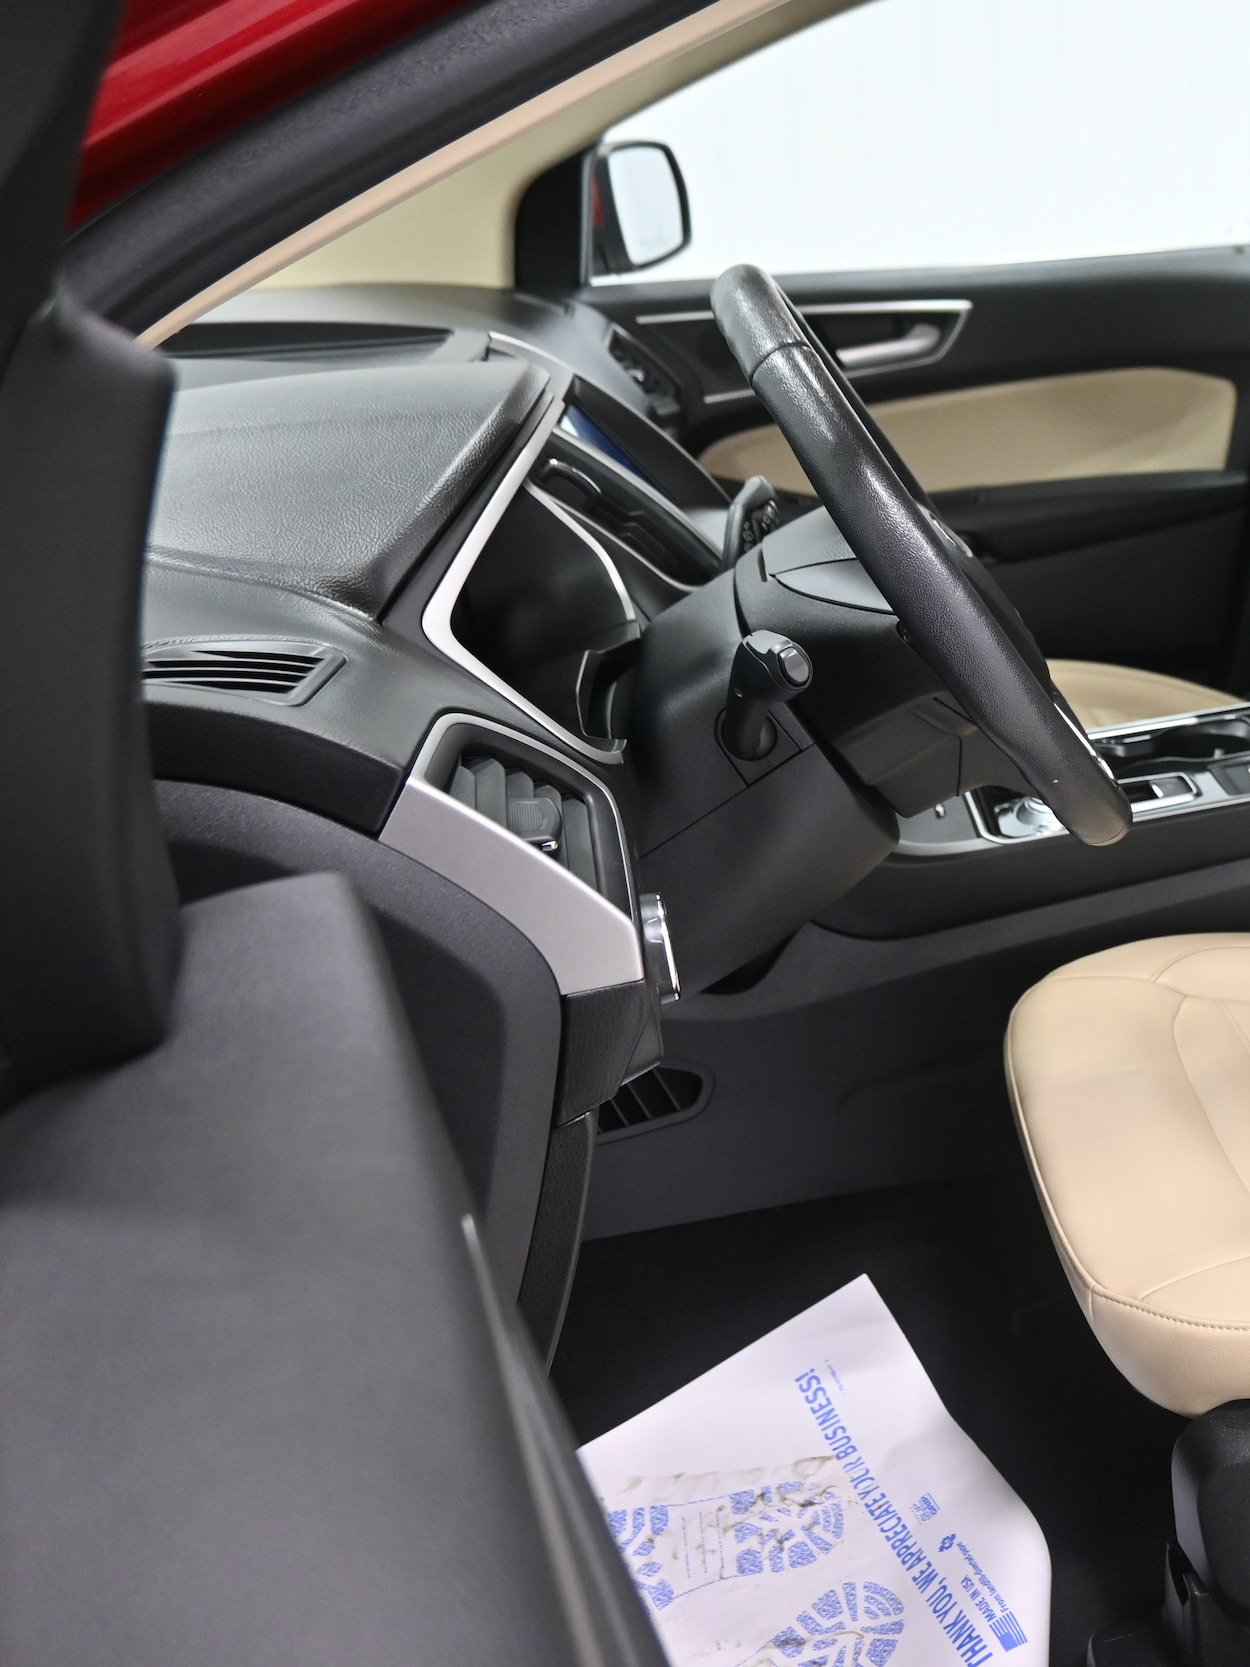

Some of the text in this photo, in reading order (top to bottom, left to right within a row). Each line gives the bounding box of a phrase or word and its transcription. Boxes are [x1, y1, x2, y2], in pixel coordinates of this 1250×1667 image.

[795, 1367, 859, 1460] BUSINESS!
[864, 1492, 927, 1571] APPRECIATE
[911, 1561, 939, 1593] WE
[926, 1577, 957, 1624] YOU,
[961, 1576, 998, 1622] MADE IN USA
[991, 1592, 1010, 1613] From
[944, 1608, 993, 1667] THANK
